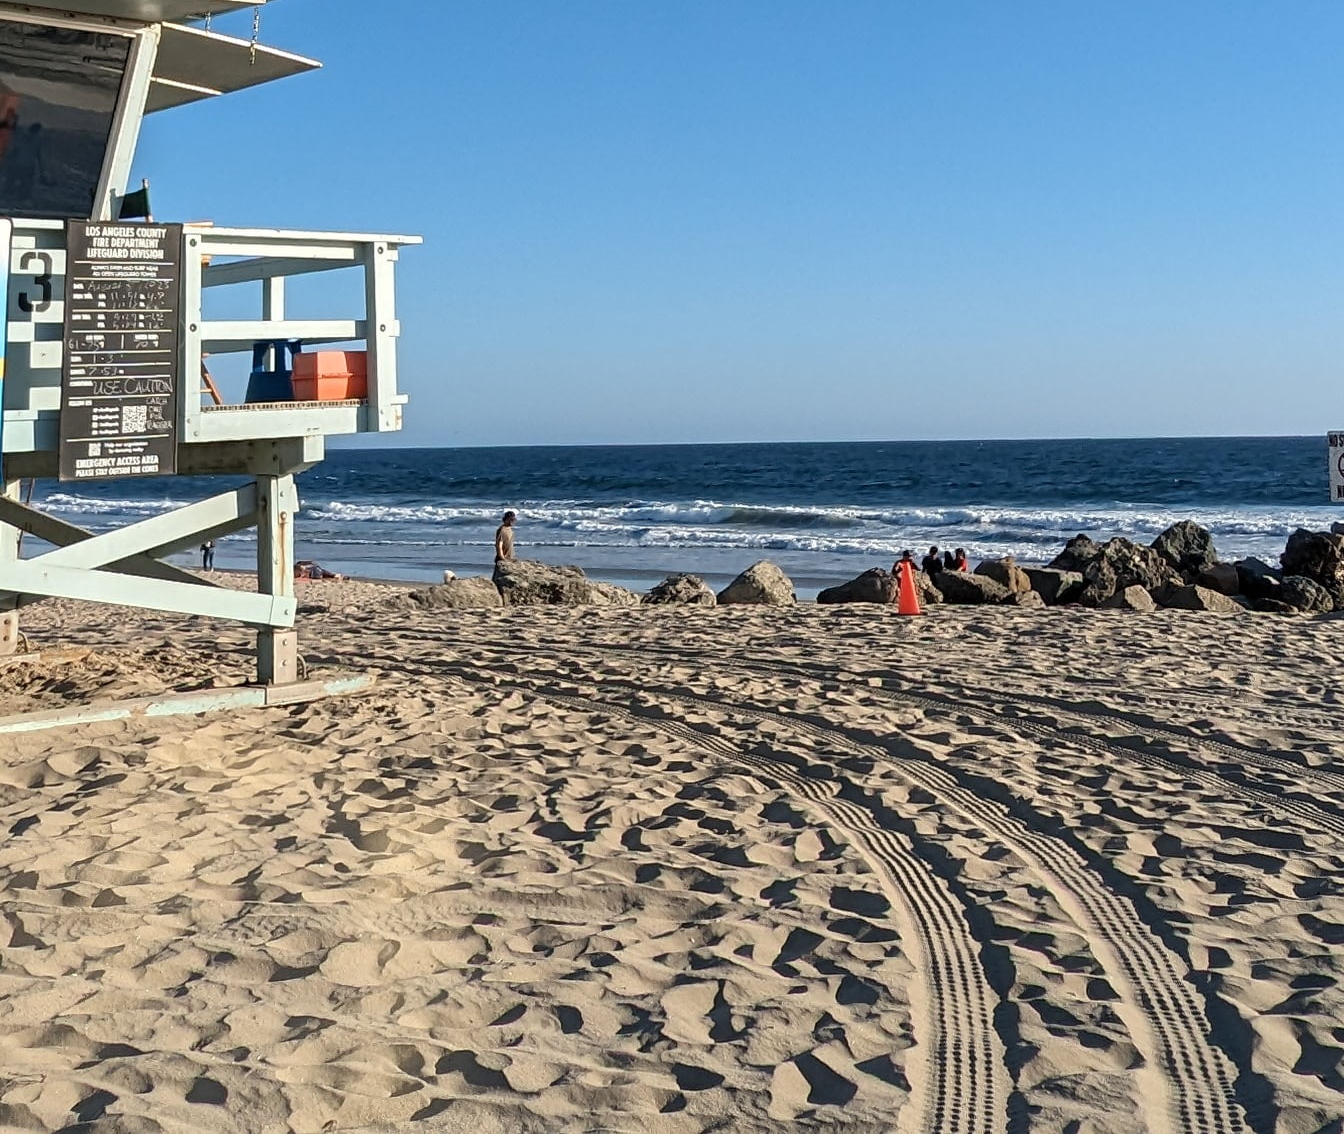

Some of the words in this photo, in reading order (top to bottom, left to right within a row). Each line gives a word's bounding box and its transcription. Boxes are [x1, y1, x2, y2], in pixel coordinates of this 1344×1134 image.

[85, 226, 101, 237] LOS
[102, 226, 135, 237] ANGELES
[136, 227, 167, 239] COUNTY
[93, 237, 110, 248] FIRE
[111, 238, 160, 249] DEPARTMENT
[87, 248, 129, 259] LIFEGUARD
[130, 248, 164, 259] DIVISION
[93, 380, 122, 395] USE
[124, 376, 173, 394] CAUTION
[1328, 434, 1338, 447] NO
[76, 458, 116, 469] EMERGENCY
[116, 456, 141, 466] ACCESS
[141, 455, 159, 465] AREA
